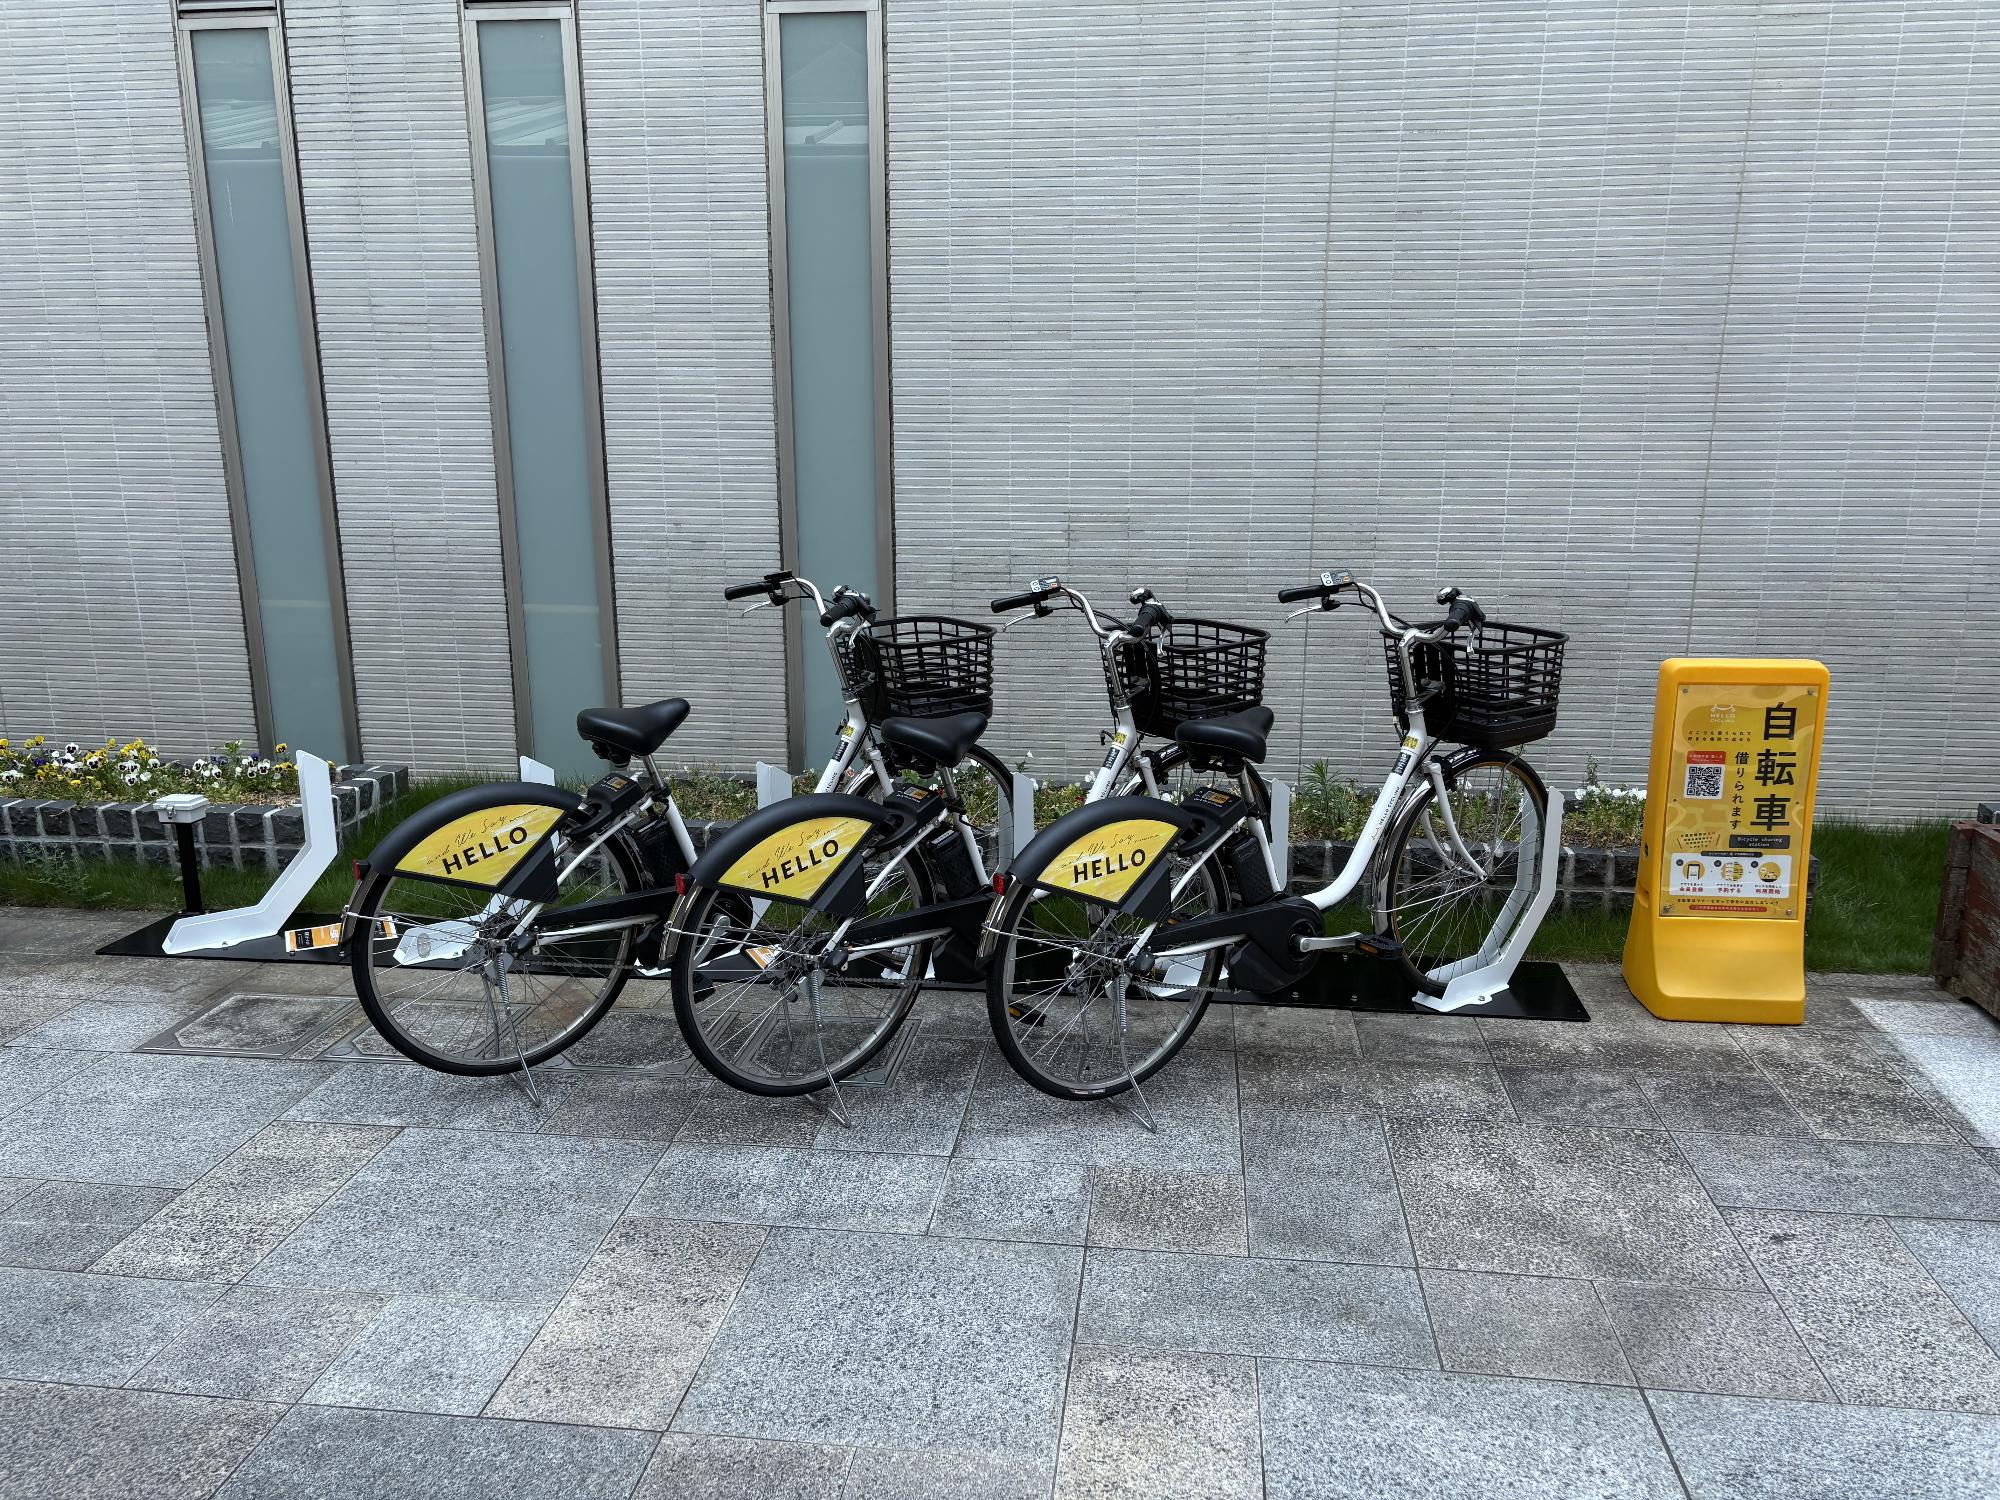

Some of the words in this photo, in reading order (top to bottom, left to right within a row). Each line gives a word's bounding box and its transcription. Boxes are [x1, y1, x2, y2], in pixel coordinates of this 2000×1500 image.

[1730, 752, 1750, 830] 借りられます
[1750, 702, 1798, 831] 自転車
[442, 826, 528, 875] HELLO
[762, 839, 839, 888] HELLO
[1073, 848, 1146, 884] HELLO
